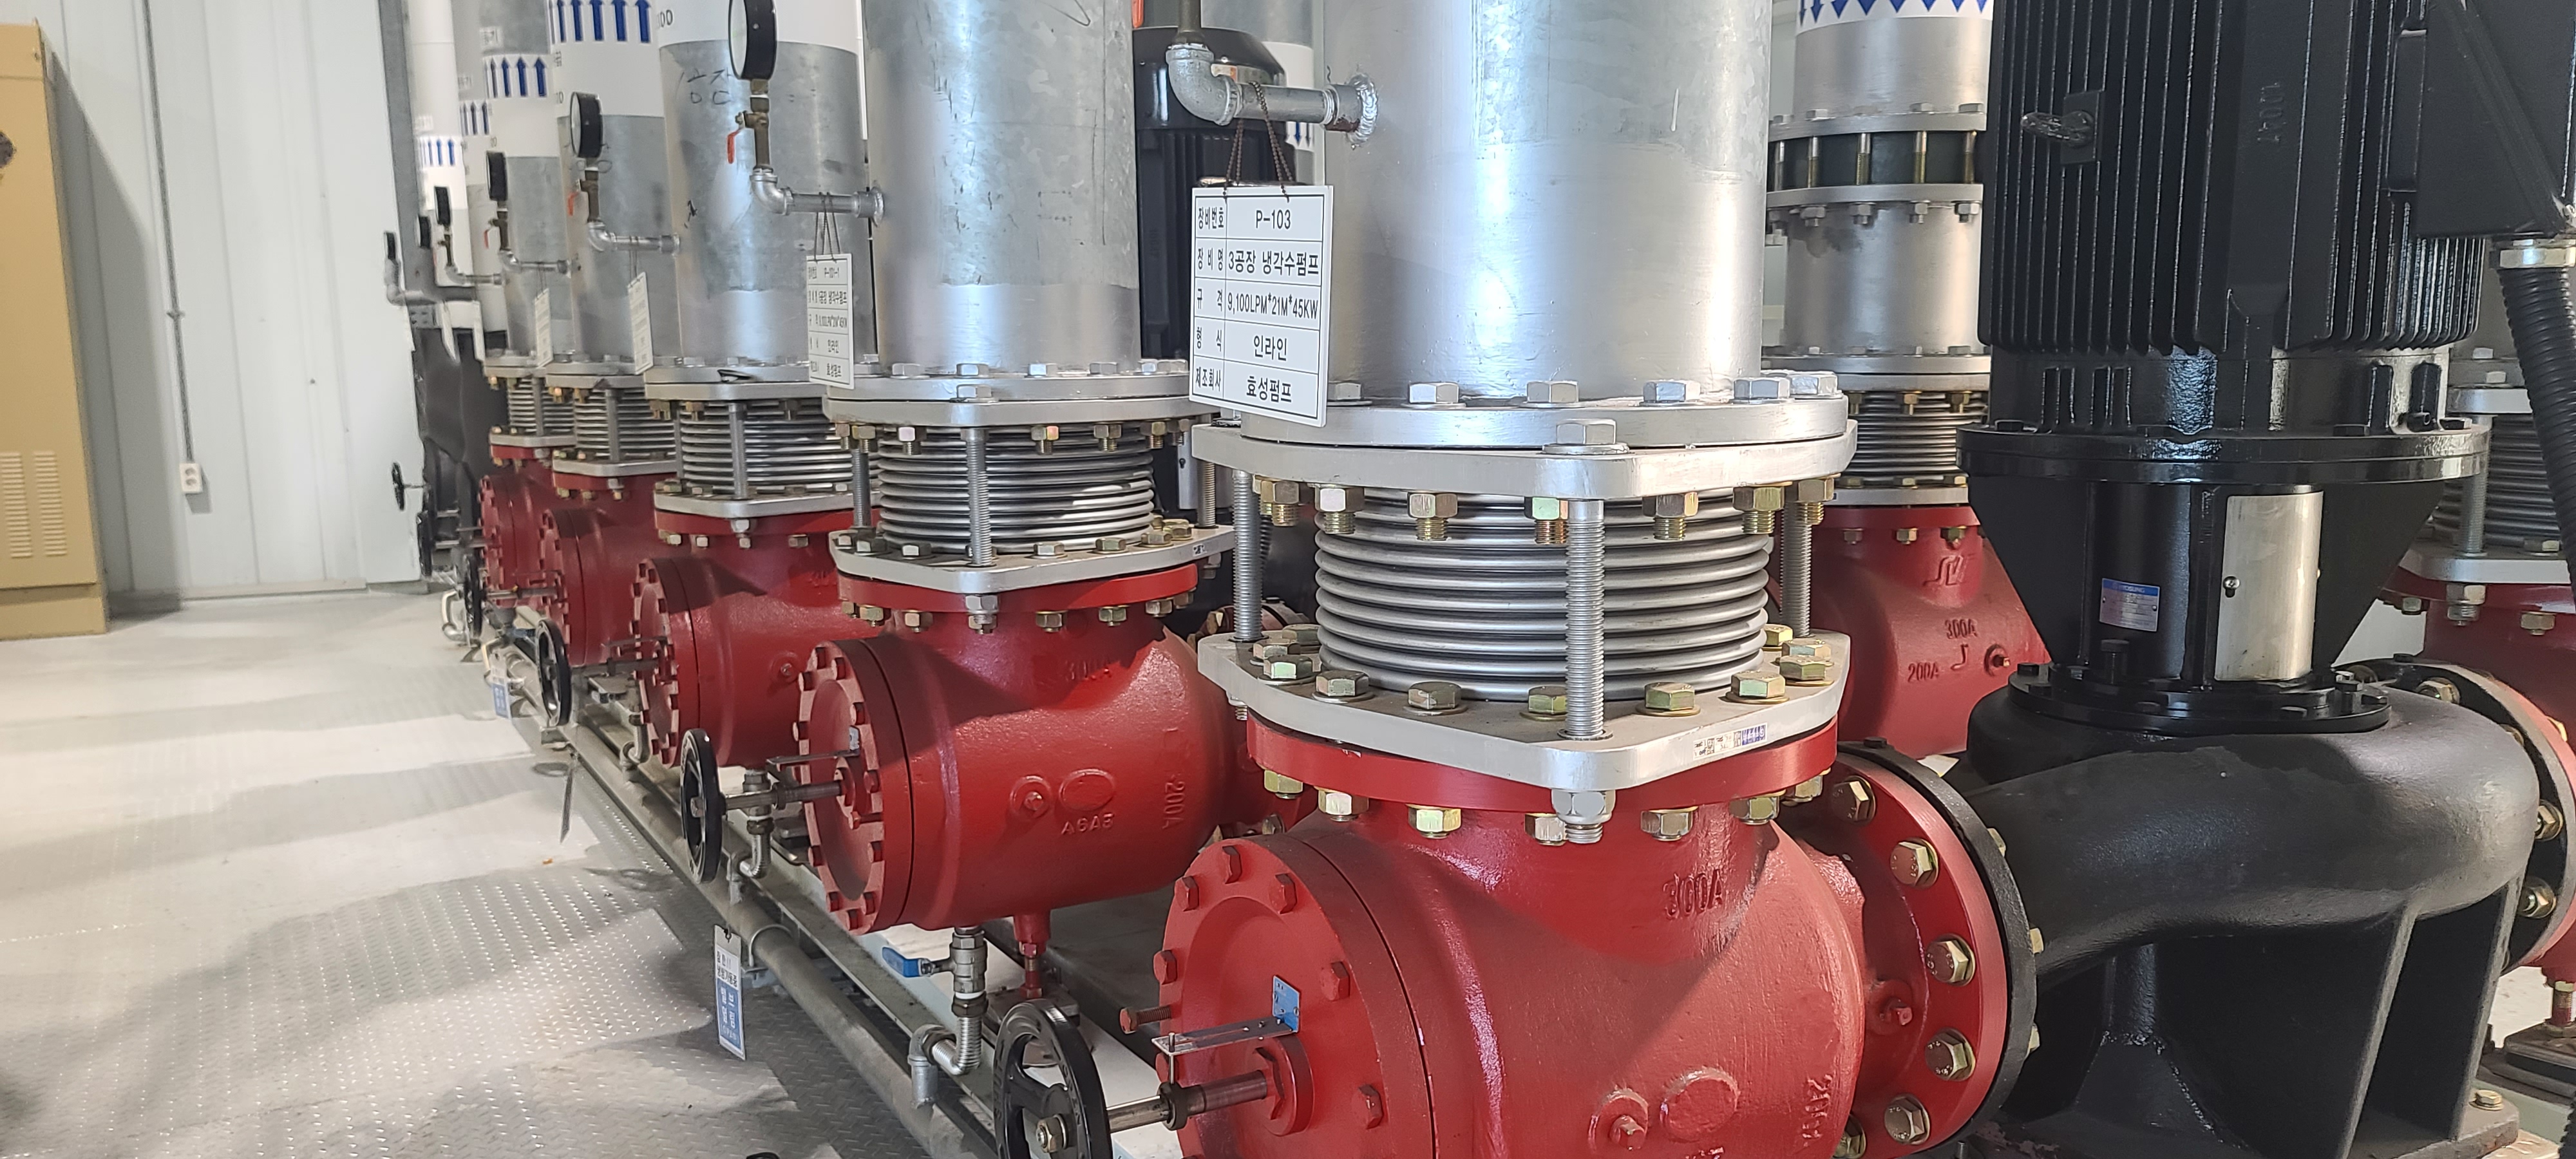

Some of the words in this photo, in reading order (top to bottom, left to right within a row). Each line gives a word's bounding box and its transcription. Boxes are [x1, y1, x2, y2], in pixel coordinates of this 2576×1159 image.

[1198, 207, 1224, 230] 장비번호
[1255, 209, 1292, 230] P-103
[1228, 249, 1256, 274] 3공장
[1262, 250, 1320, 277] 냉각수펌프
[1253, 335, 1287, 362] 인라인
[1195, 366, 1222, 392] 제조회사
[1246, 375, 1292, 403] 효성펌프
[1944, 617, 1979, 639] 300A
[1662, 869, 1724, 920] 300A
